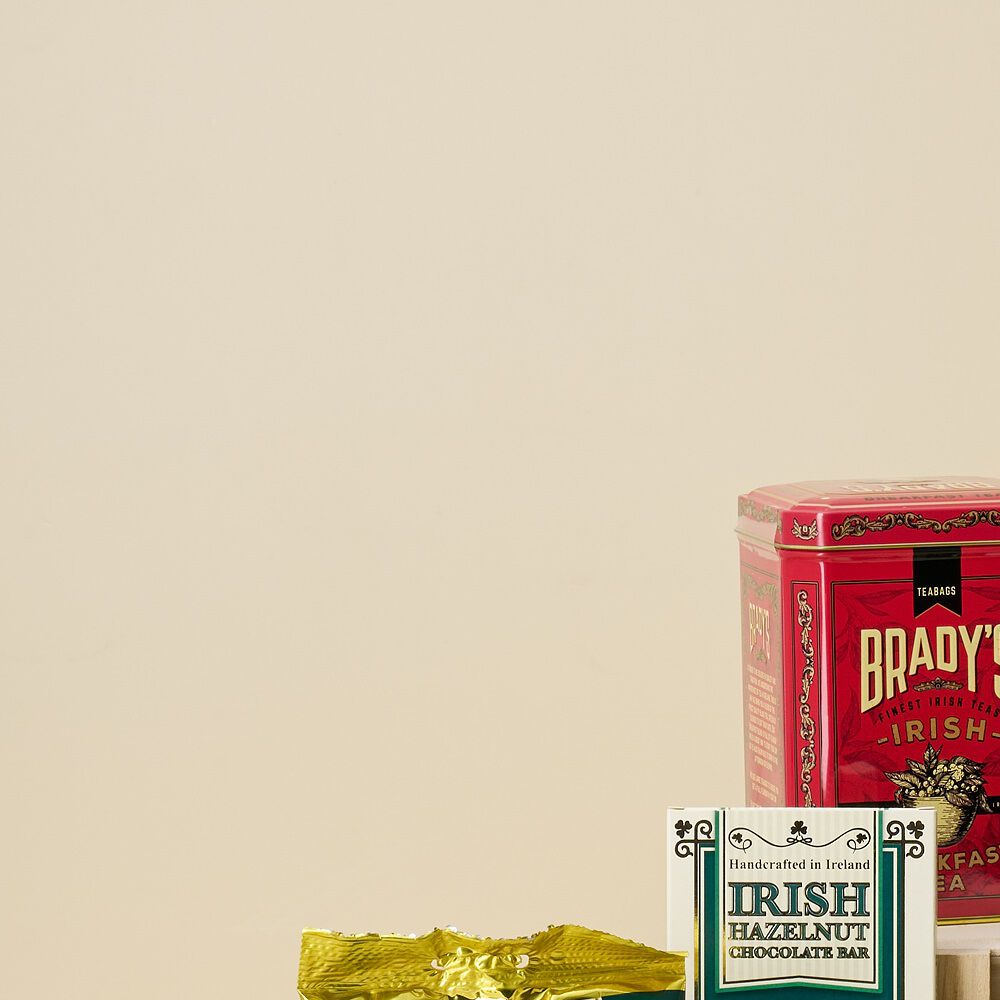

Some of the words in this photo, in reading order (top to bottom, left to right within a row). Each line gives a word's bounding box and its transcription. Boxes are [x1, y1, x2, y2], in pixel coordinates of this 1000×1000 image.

[917, 586, 957, 597] TEABAGS
[878, 698, 922, 723] FINEST
[929, 697, 963, 707] IRISH
[971, 699, 1000, 719] TEAS
[729, 858, 806, 870] Handcrafted
[810, 858, 822, 870] in
[826, 858, 870, 870] Ireland
[936, 874, 966, 891] EA
[728, 882, 871, 918] IRISH
[728, 922, 870, 941] HAZELNUT
[728, 946, 834, 959] CHOCOLATE
[836, 946, 871, 959] BAR
